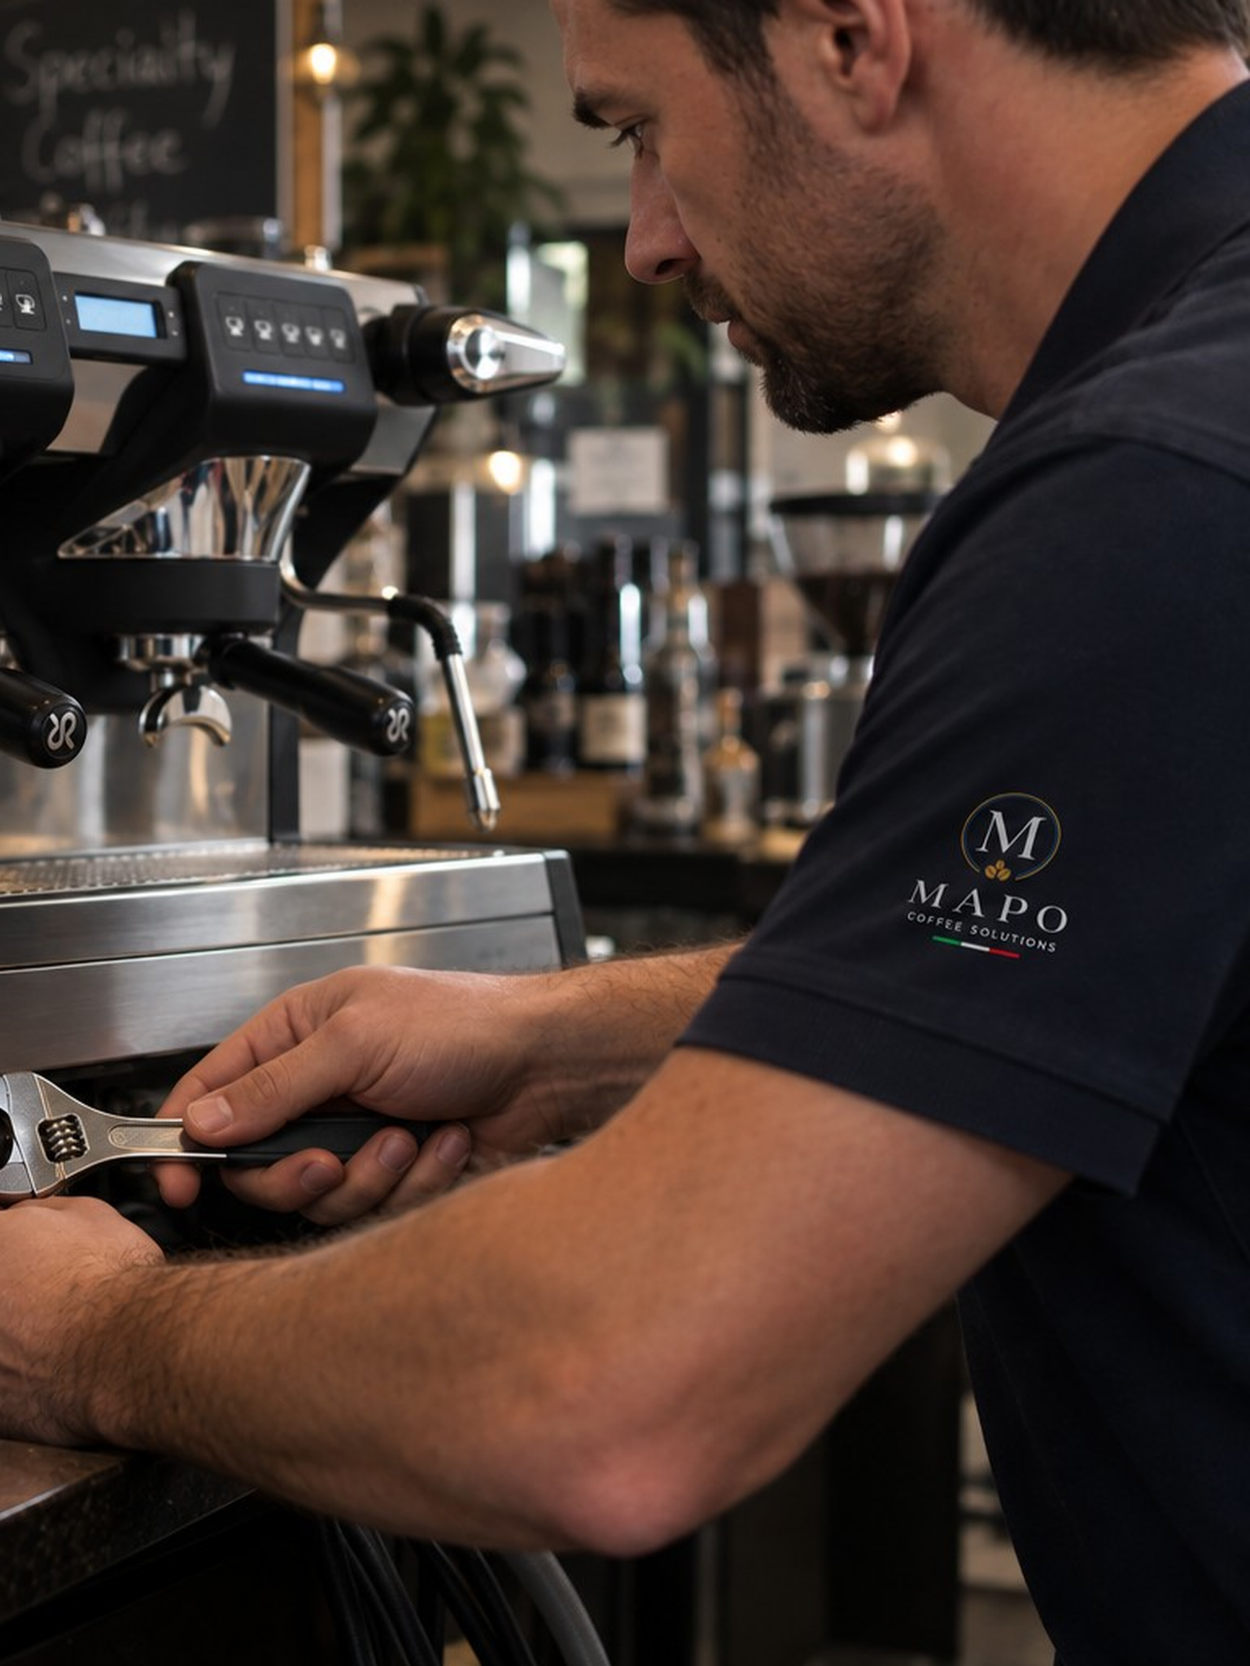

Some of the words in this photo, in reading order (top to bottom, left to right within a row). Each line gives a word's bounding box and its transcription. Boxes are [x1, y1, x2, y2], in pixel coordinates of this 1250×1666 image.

[22, 108, 191, 194] Coffee
[974, 809, 1047, 860] M
[907, 879, 1068, 934] MAPO
[907, 911, 962, 932] COFFEE
[970, 925, 1056, 953] SOLUTIONS
